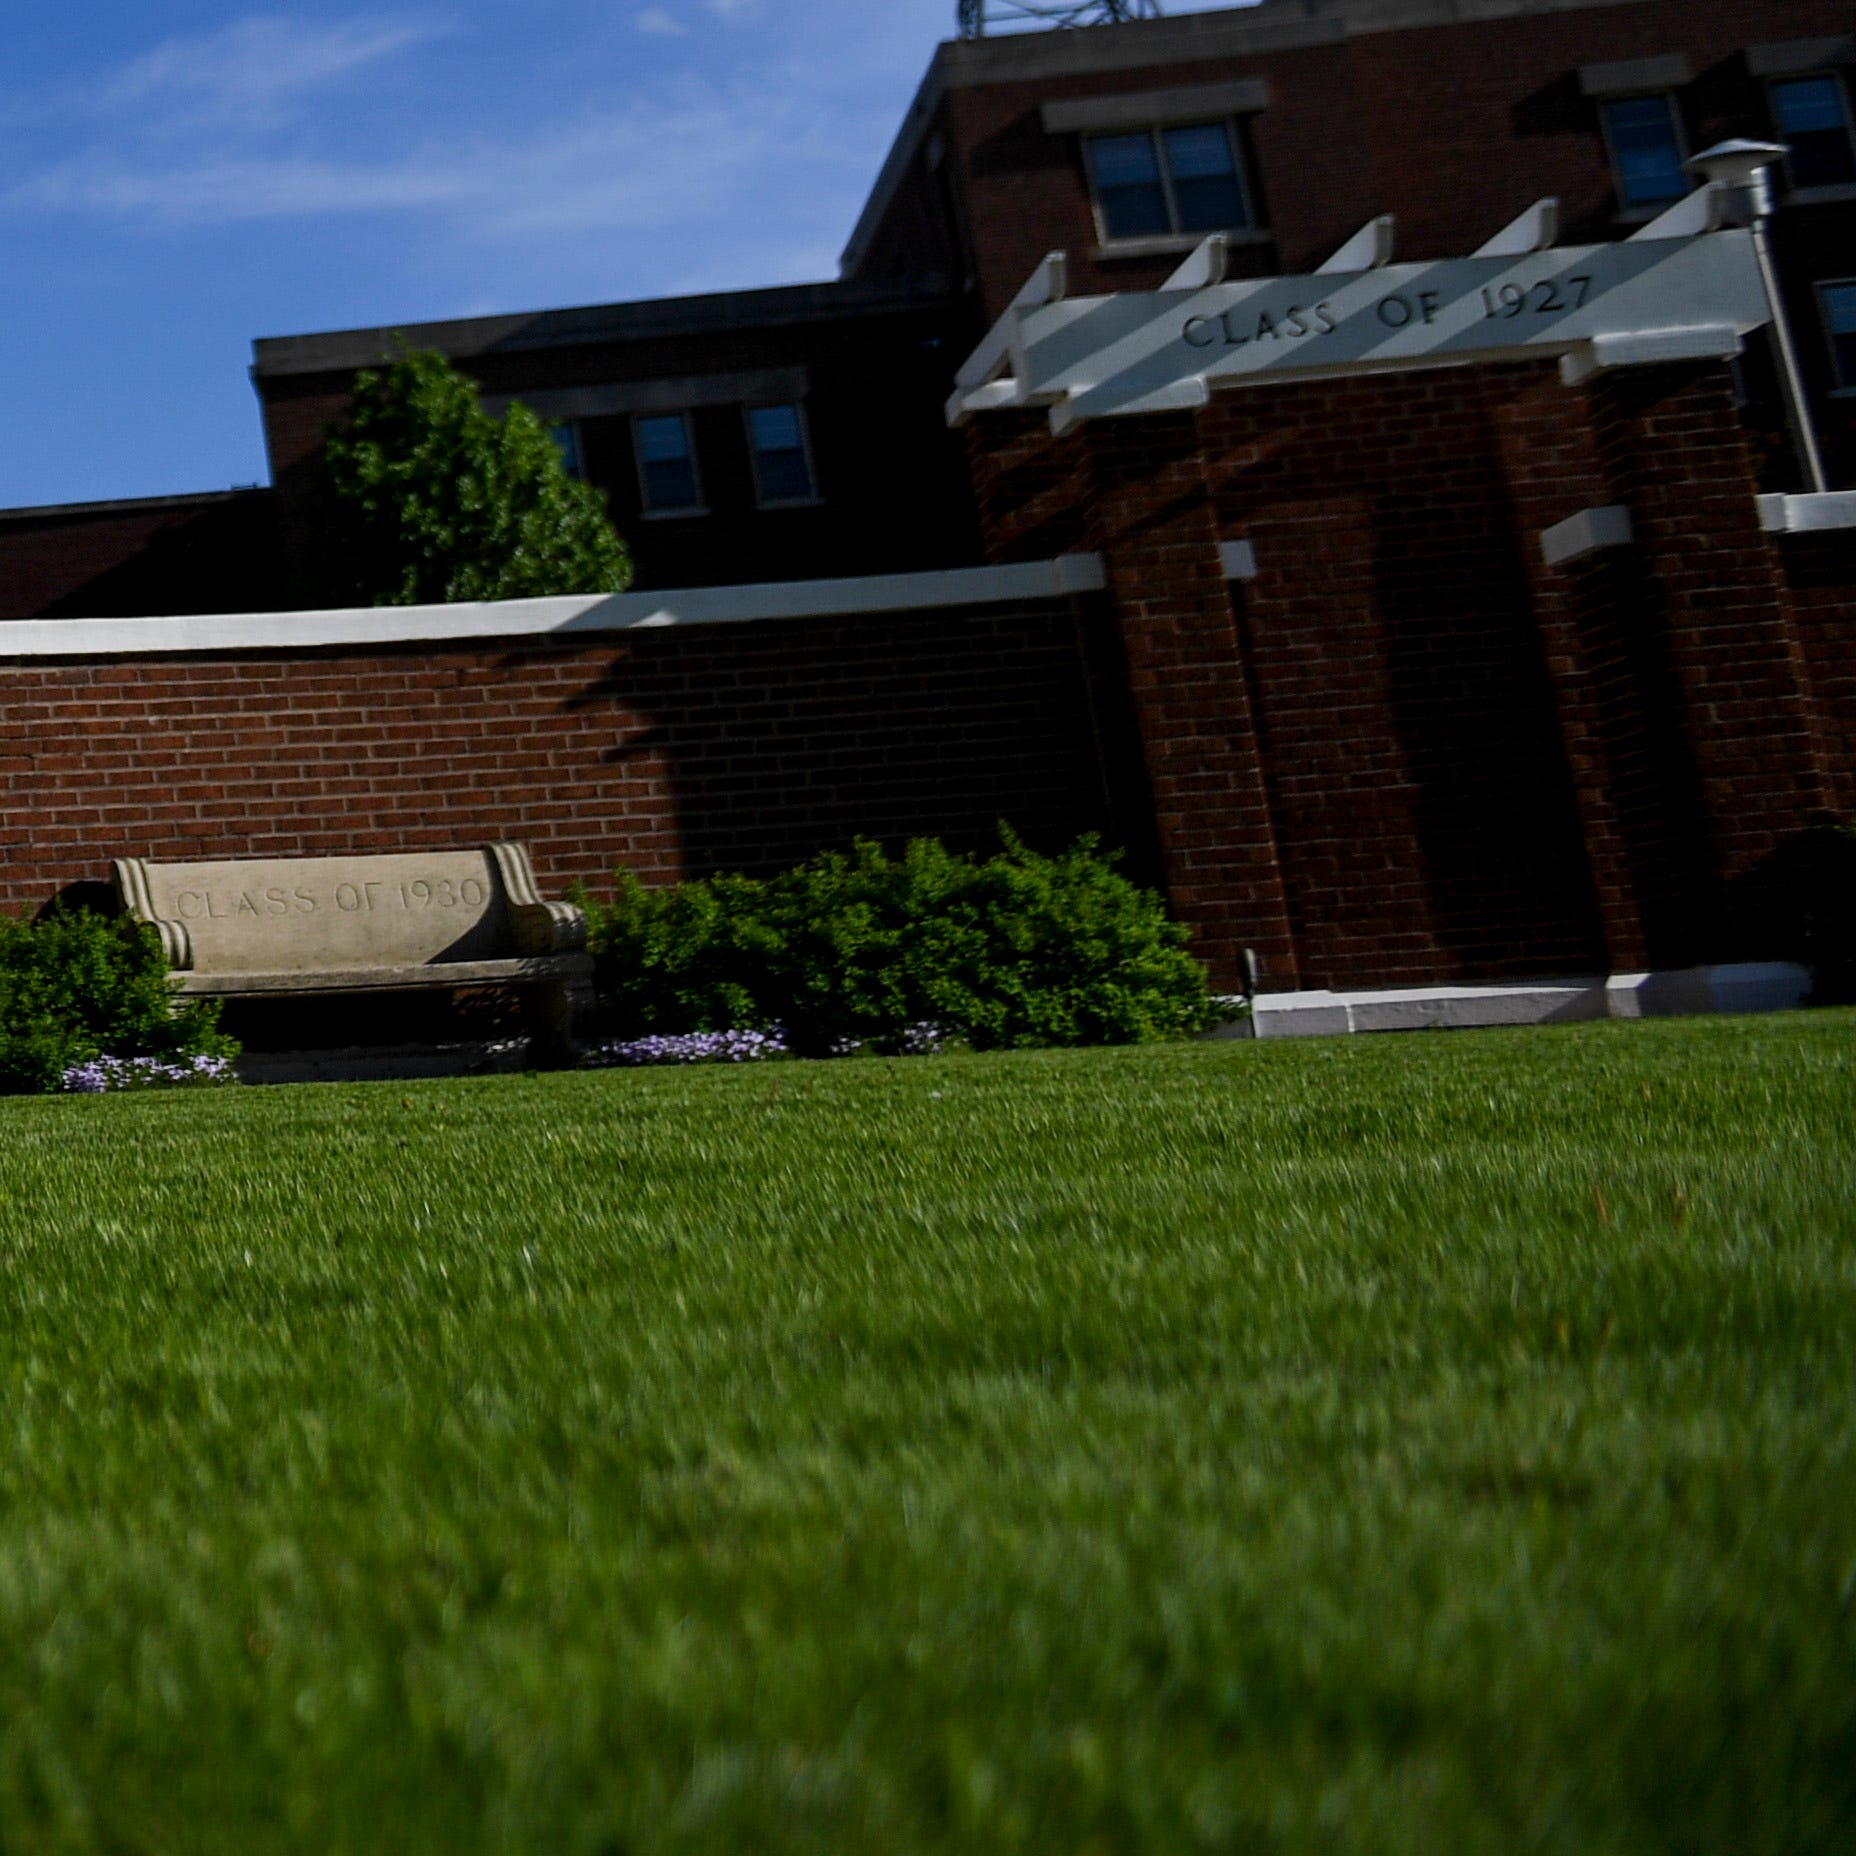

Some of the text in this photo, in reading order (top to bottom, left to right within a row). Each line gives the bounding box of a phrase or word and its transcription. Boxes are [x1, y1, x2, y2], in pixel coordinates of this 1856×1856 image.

[1182, 276, 1594, 349] CLASS OF 1927
[175, 878, 483, 920] CLASS OF 1930
